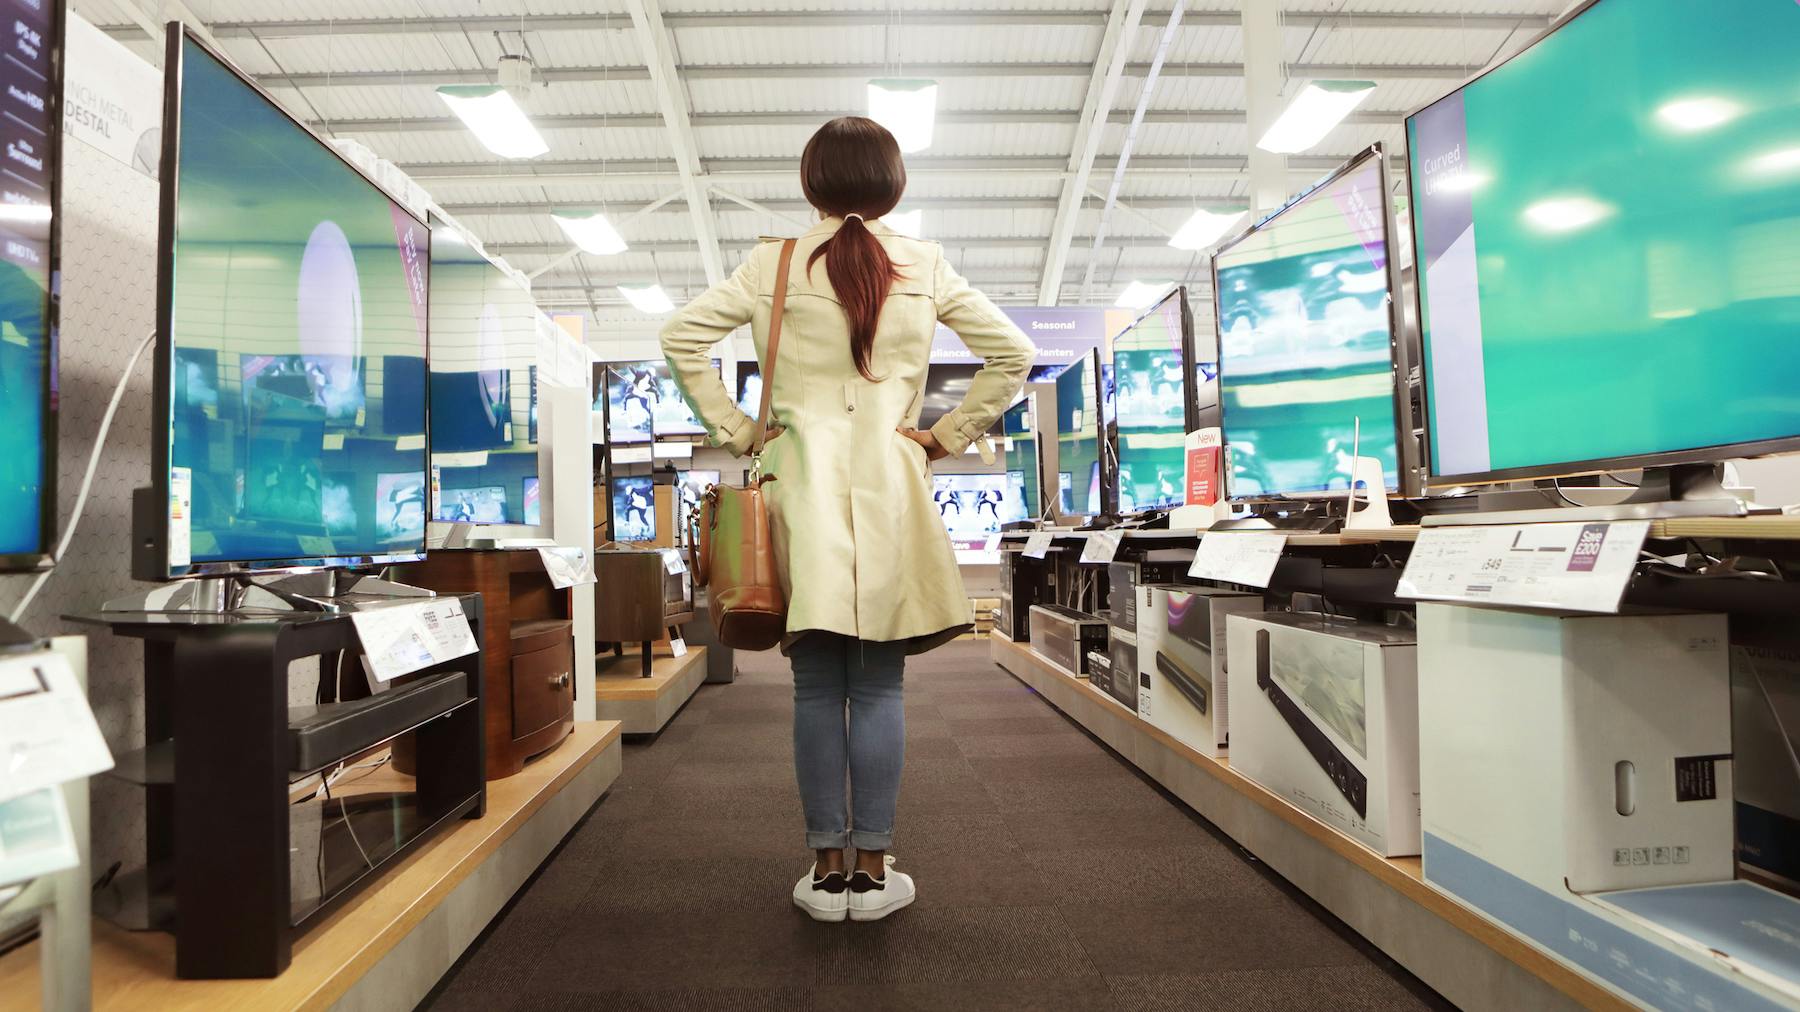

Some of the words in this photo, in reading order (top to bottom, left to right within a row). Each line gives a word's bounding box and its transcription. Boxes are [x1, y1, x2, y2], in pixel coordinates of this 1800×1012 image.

[100, 97, 135, 132] METAL
[1424, 143, 1460, 175] Curved
[1031, 320, 1076, 330] Seasonal
[1197, 433, 1216, 444] New
[1581, 530, 1603, 543] Save
[1575, 542, 1600, 555] £200
